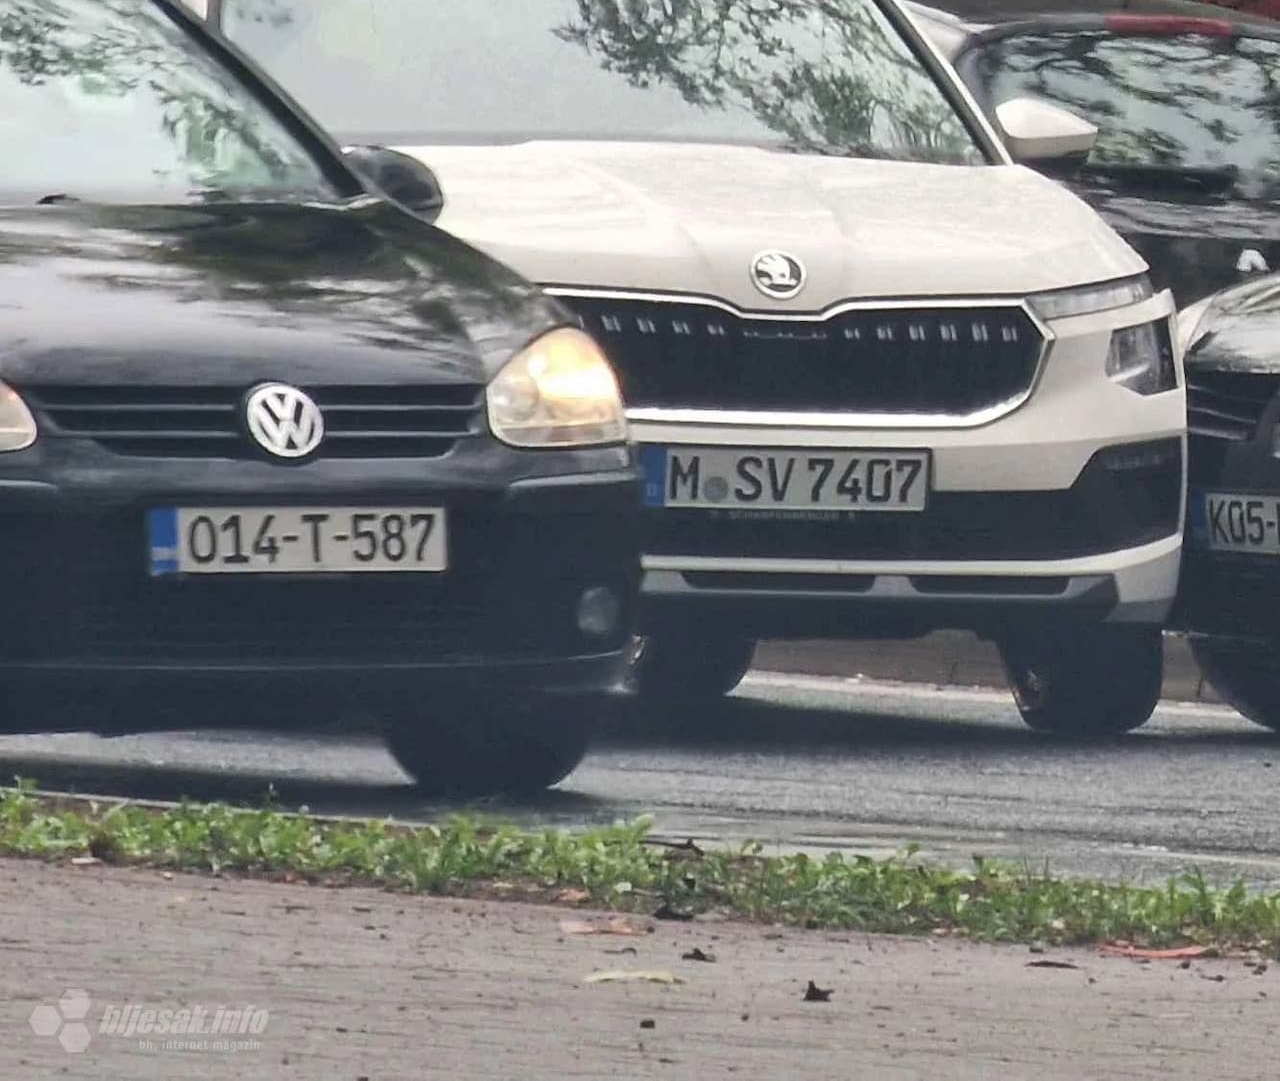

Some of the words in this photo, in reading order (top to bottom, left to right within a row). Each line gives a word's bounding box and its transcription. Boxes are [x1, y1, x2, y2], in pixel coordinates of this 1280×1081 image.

[669, 455, 700, 500] M
[734, 456, 796, 502] SV
[807, 457, 923, 504] 7407
[187, 513, 437, 564] 014-T-587
